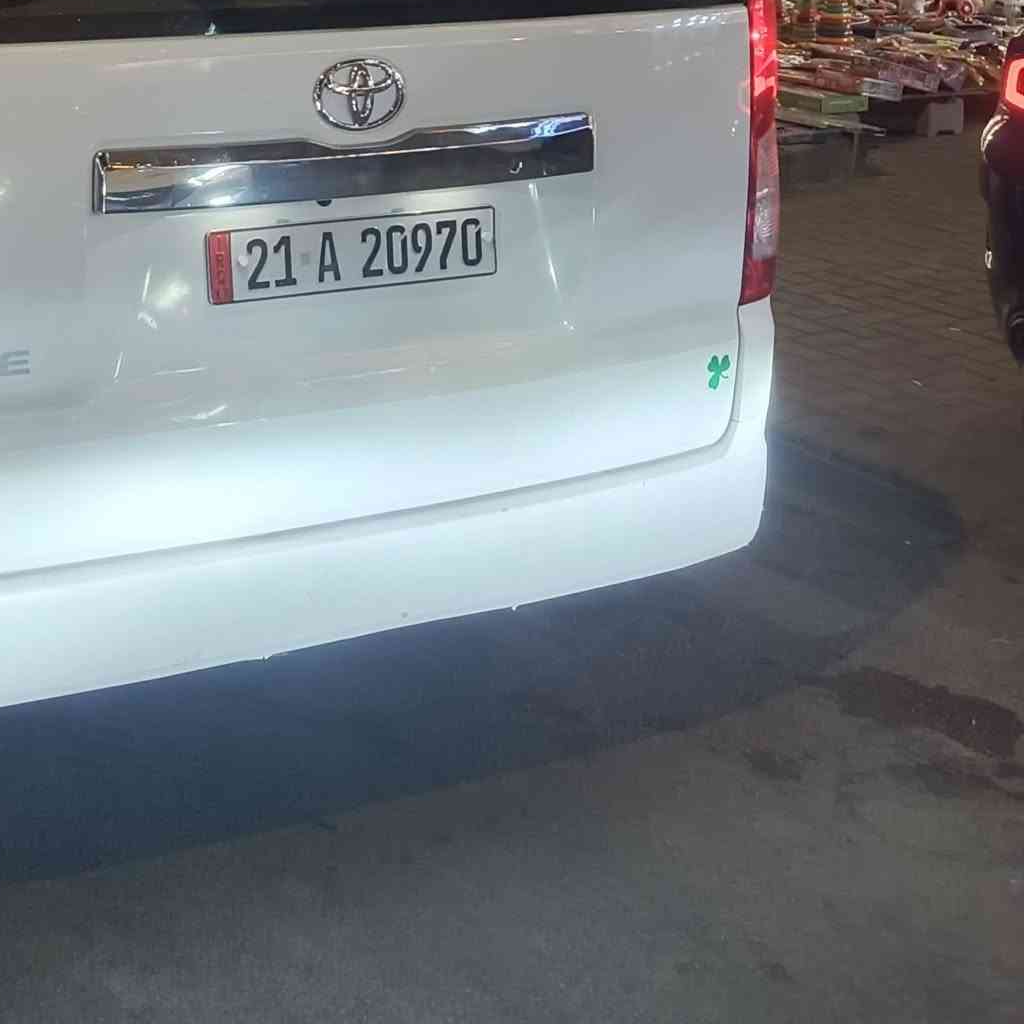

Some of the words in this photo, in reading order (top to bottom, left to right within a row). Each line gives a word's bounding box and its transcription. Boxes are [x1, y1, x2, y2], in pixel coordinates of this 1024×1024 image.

[246, 235, 297, 290] 21
[318, 231, 342, 282] A
[360, 218, 483, 278] 20970
